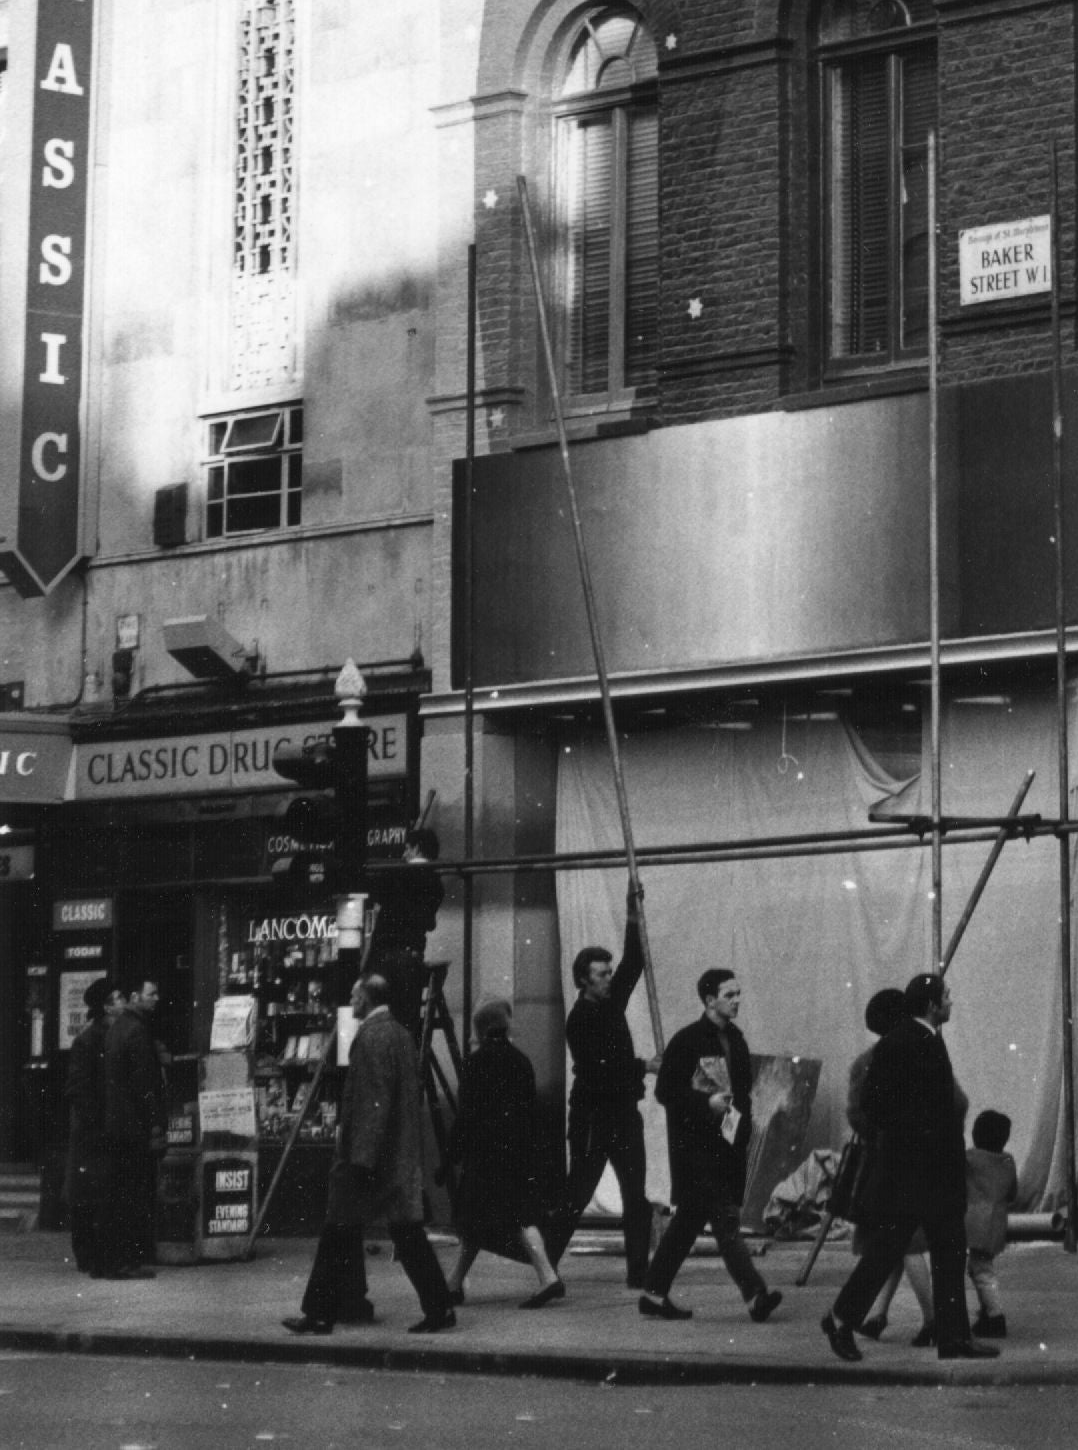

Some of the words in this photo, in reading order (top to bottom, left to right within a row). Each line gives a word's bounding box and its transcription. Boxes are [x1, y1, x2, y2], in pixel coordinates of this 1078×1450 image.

[981, 243, 1034, 269] BAKER
[970, 269, 1020, 295] STREET
[87, 745, 200, 786] CLASSIC
[303, 725, 397, 762] SRE
[367, 826, 407, 847] GRAPHY
[61, 902, 106, 923] CLASSIC
[67, 947, 102, 959] TODAY
[215, 1169, 250, 1193] INSIST
[215, 1203, 249, 1220] EVENING
[208, 1219, 249, 1234] STANDARD
